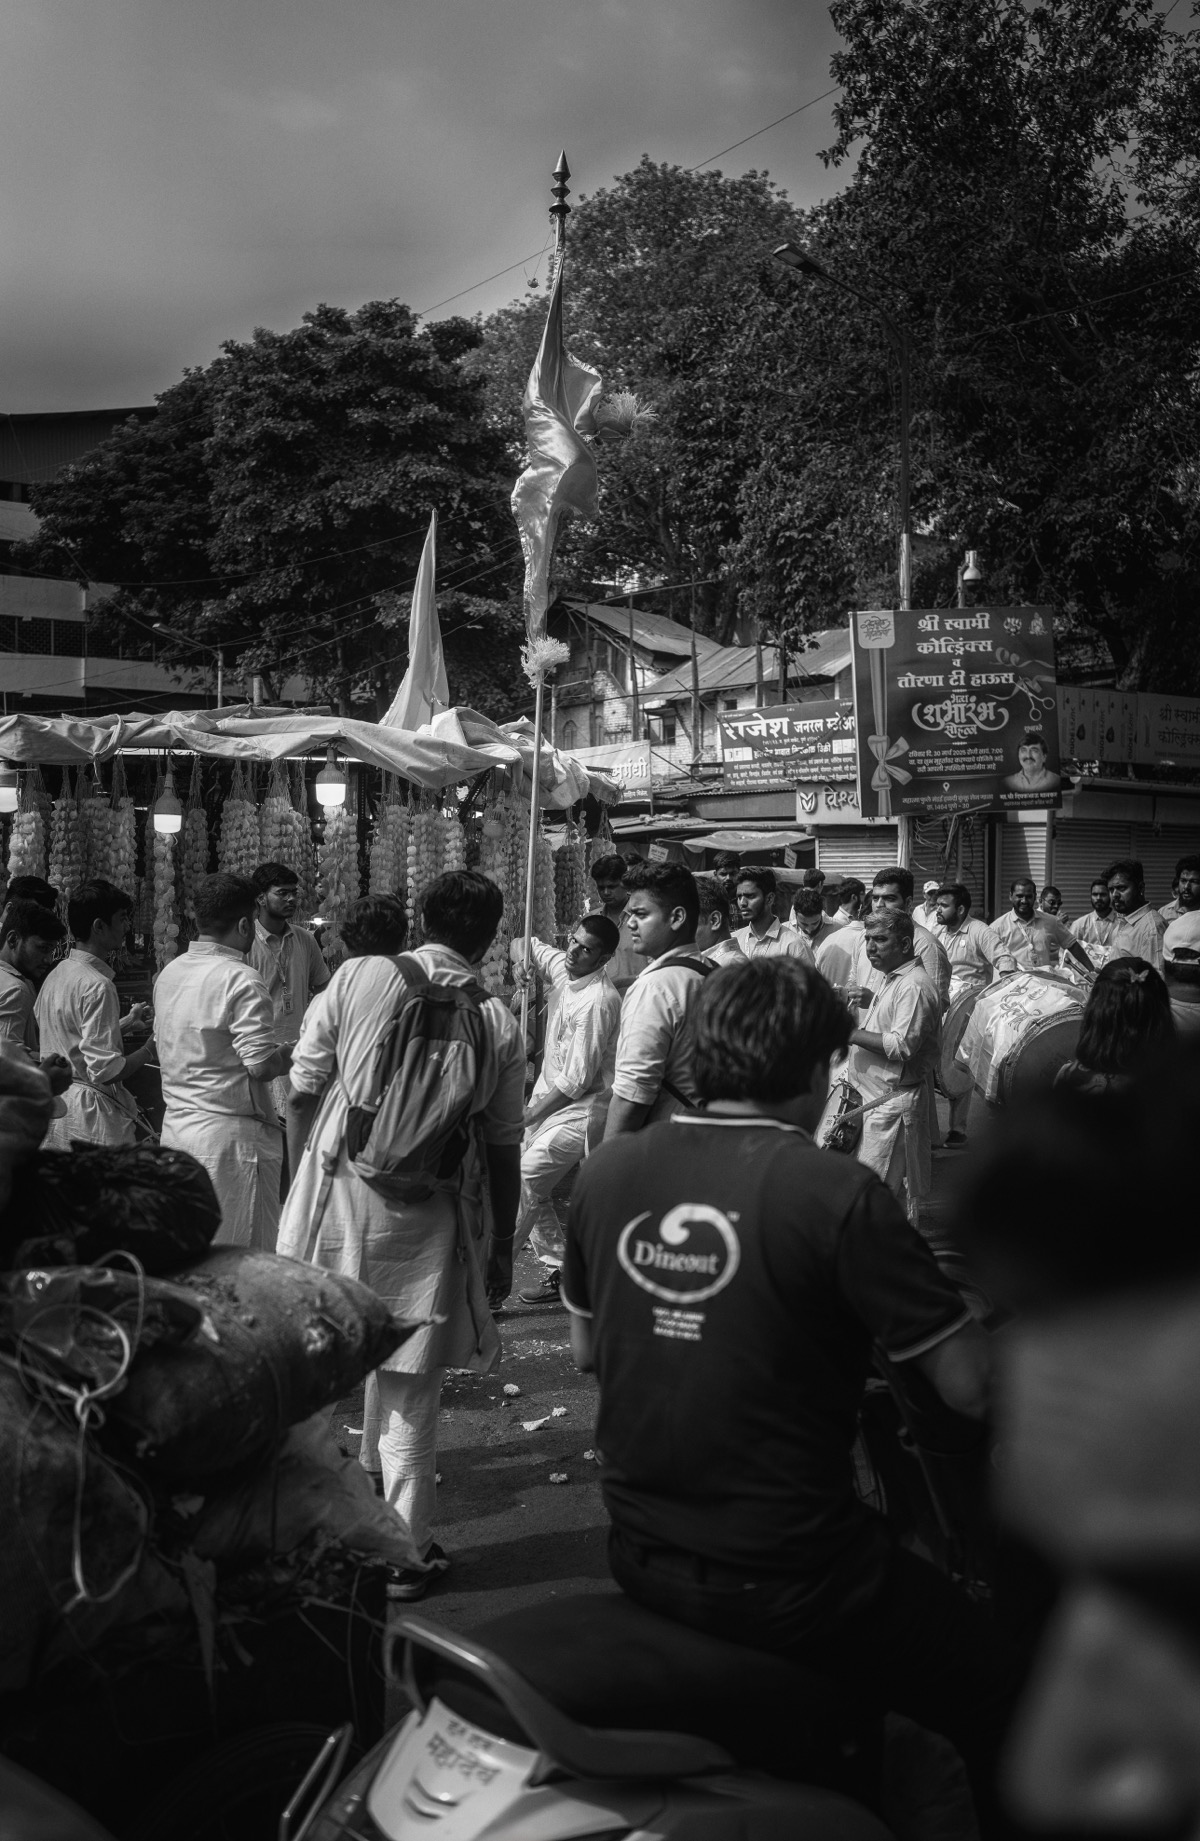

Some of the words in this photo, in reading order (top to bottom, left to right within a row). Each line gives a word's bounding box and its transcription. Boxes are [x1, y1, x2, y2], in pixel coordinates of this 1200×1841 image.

[917, 614, 940, 632] श्री
[943, 612, 991, 631] स्वामी
[916, 636, 994, 656] कोल्ड्रिंक्स
[951, 658, 961, 667] व
[896, 671, 945, 688] तोरणा
[948, 669, 966, 686] टी
[969, 672, 1015, 687] हाऊस
[911, 694, 1010, 732] शुभारंभ
[1159, 703, 1172, 721] श्री
[722, 712, 790, 740] राजेश
[793, 719, 824, 734] जनरल
[633, 1239, 720, 1276] Dineout
